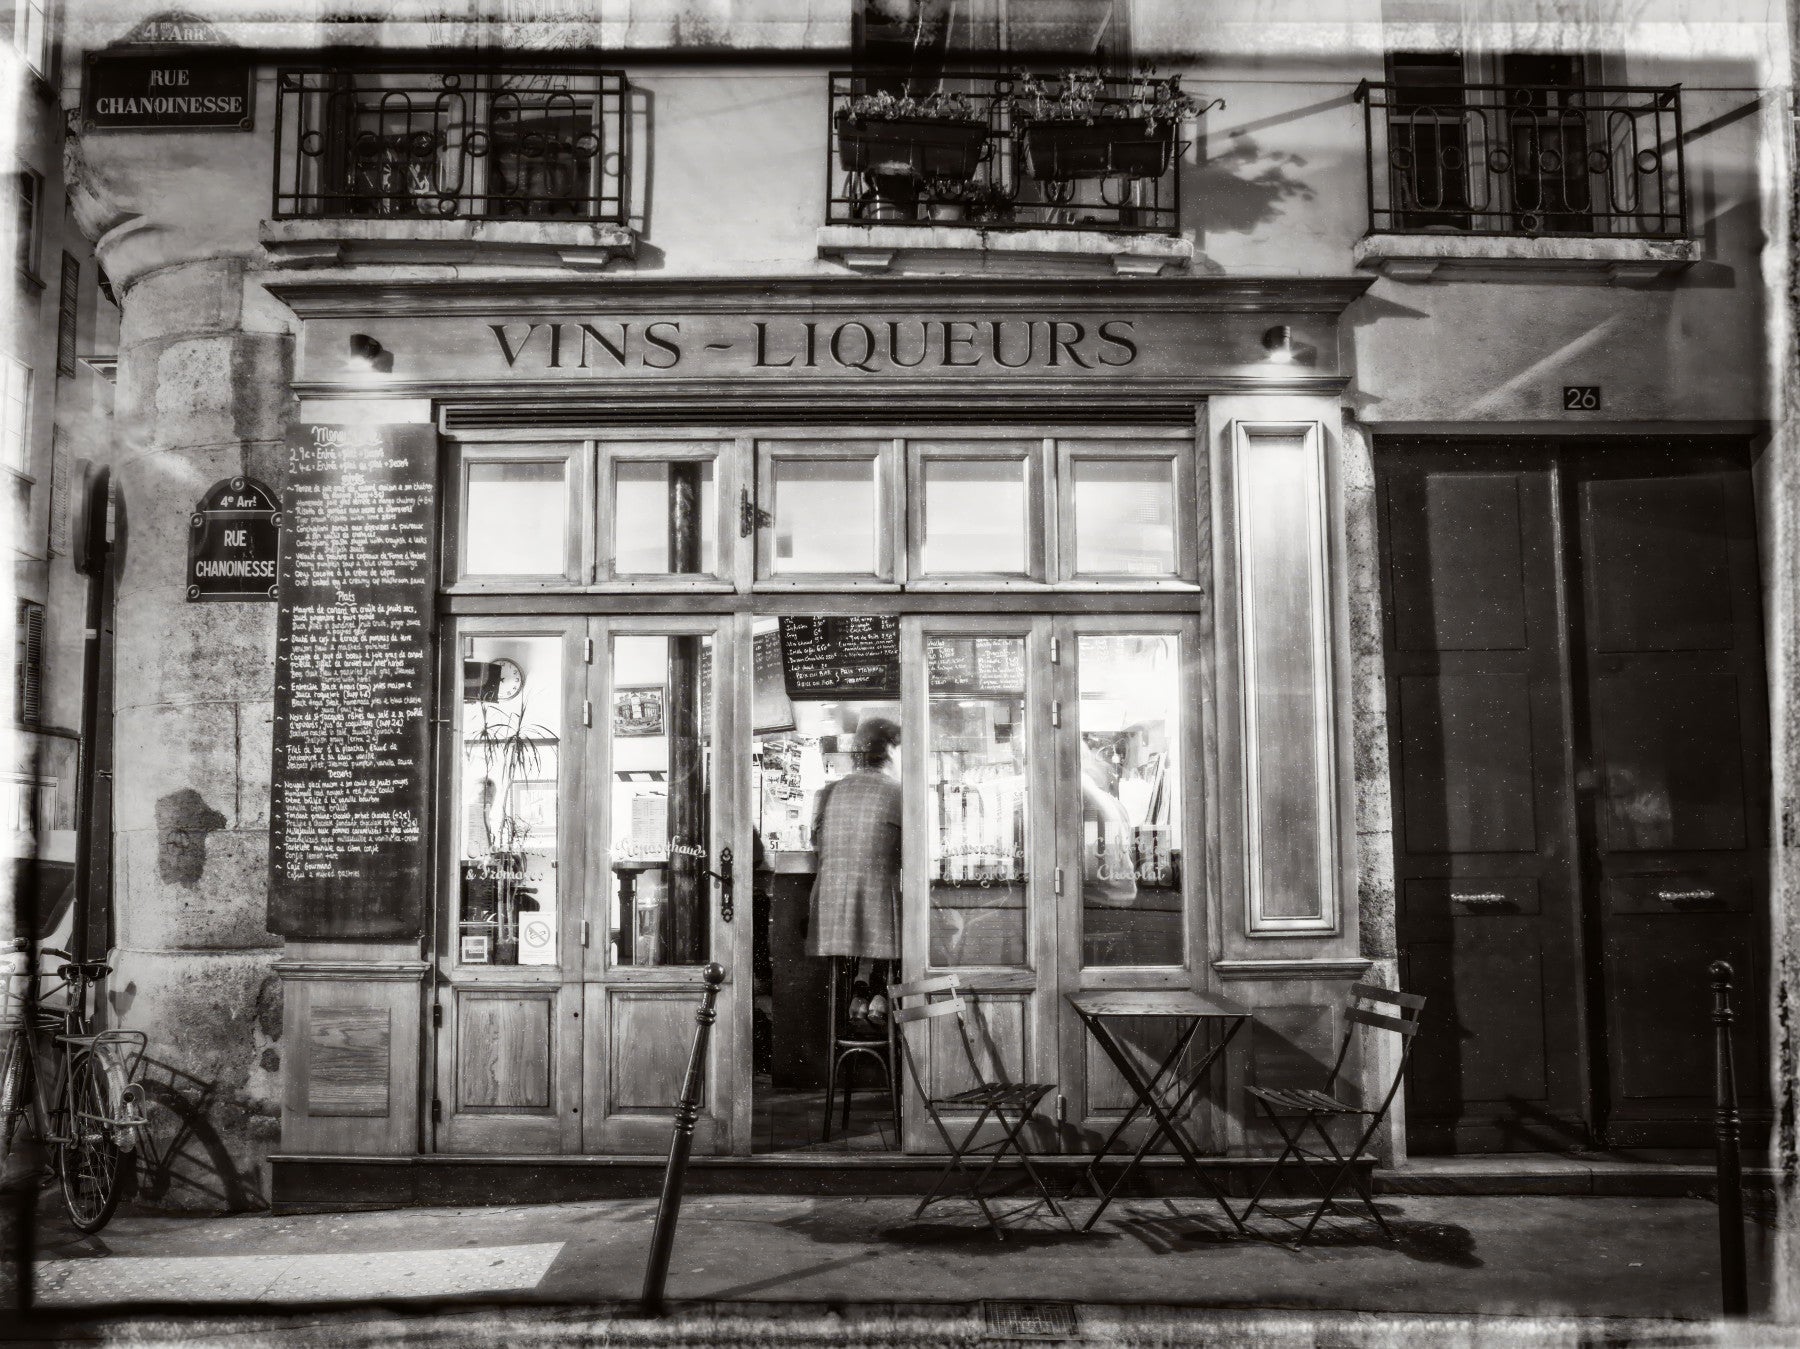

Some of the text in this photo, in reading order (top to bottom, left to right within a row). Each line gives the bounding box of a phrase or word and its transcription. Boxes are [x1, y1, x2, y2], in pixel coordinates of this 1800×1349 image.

[151, 69, 189, 86] RUE
[96, 97, 243, 114] CHANOINESSE
[487, 321, 680, 369] VINS
[752, 319, 1138, 373] LIQUEURS
[1567, 388, 1597, 409] 26
[224, 529, 248, 547] RUE
[196, 559, 276, 578] CHANOINESSE
